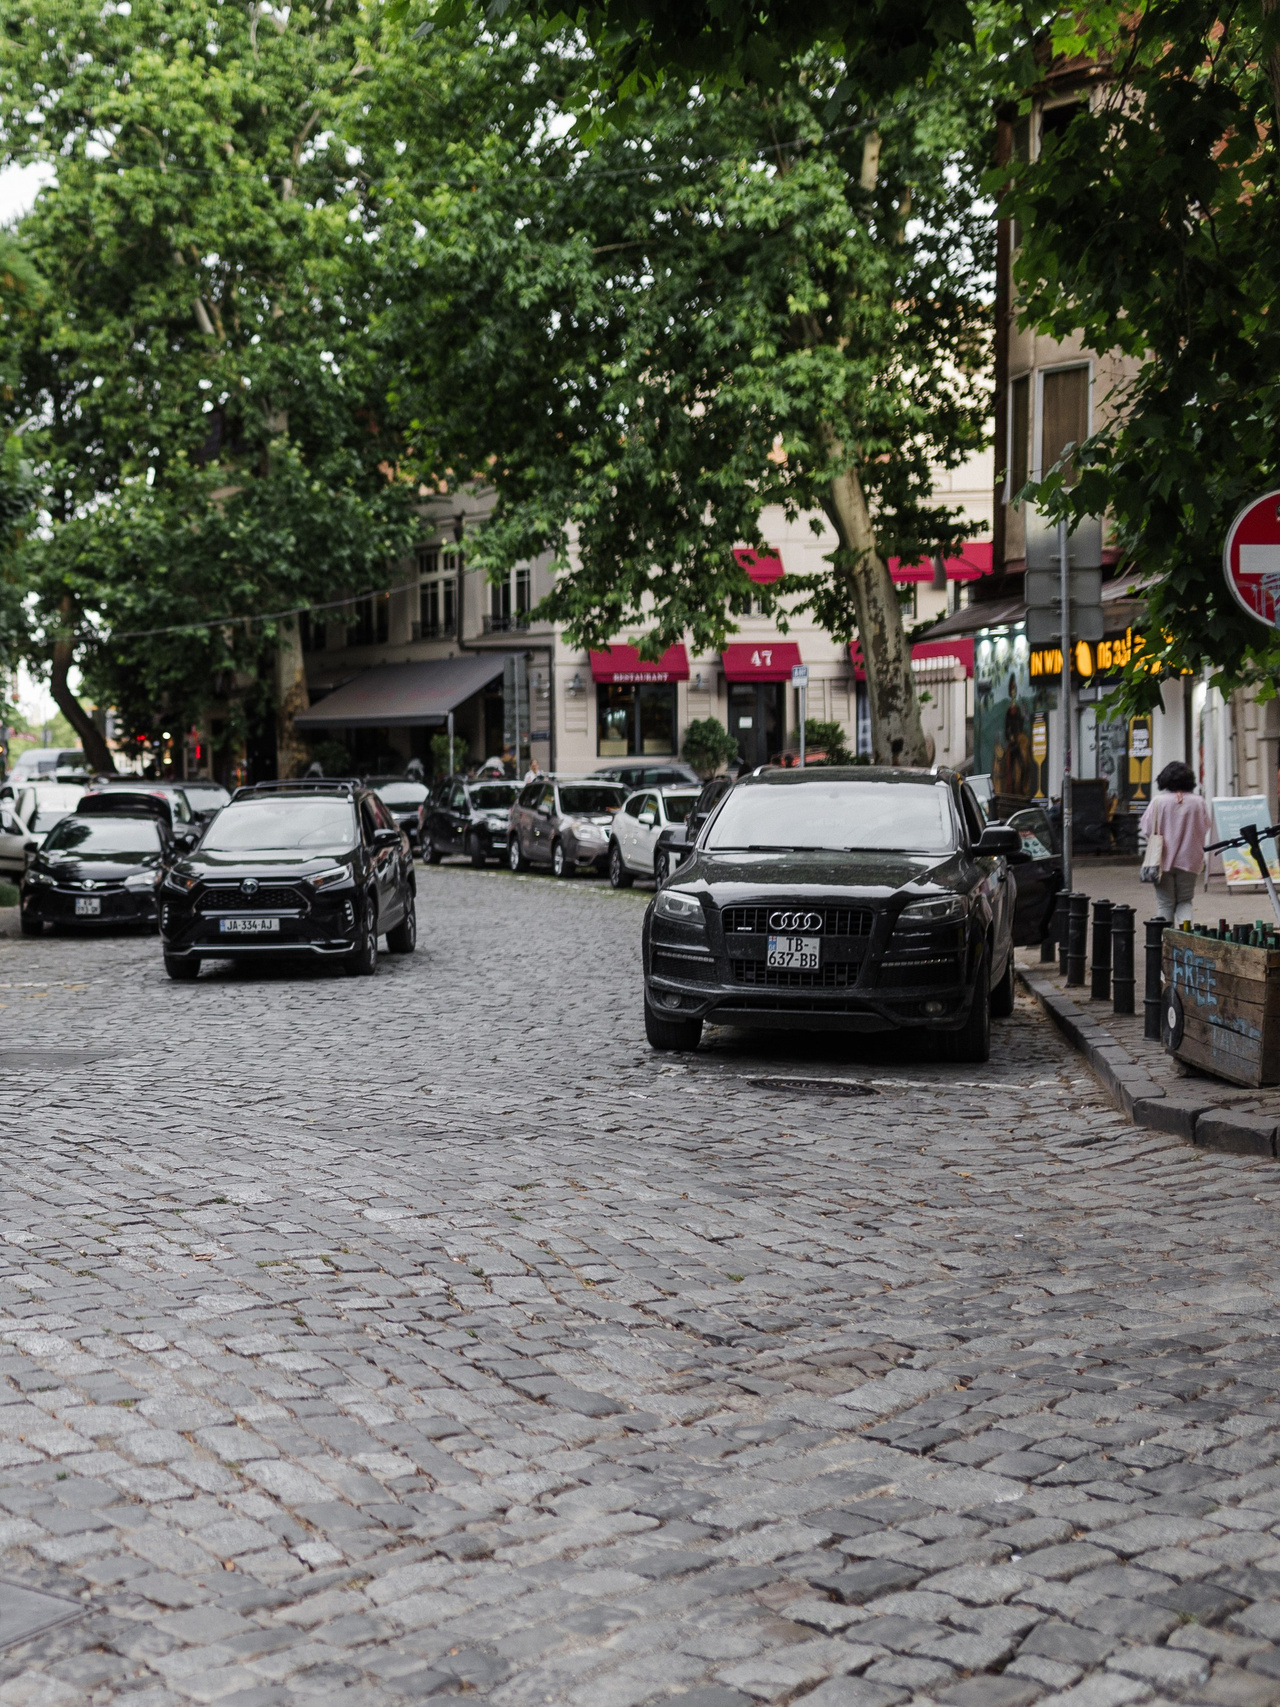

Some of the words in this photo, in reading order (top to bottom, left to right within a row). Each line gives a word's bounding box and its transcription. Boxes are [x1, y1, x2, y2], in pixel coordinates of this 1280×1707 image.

[751, 650, 772, 667] 47
[1030, 651, 1043, 676] IN
[1043, 648, 1074, 674] WIN
[613, 672, 669, 682] RESTAURANT
[226, 919, 273, 931] JA-334-AJ
[786, 937, 809, 953] TB-
[768, 951, 818, 968] 637-BB
[1172, 946, 1218, 1007] FREE
